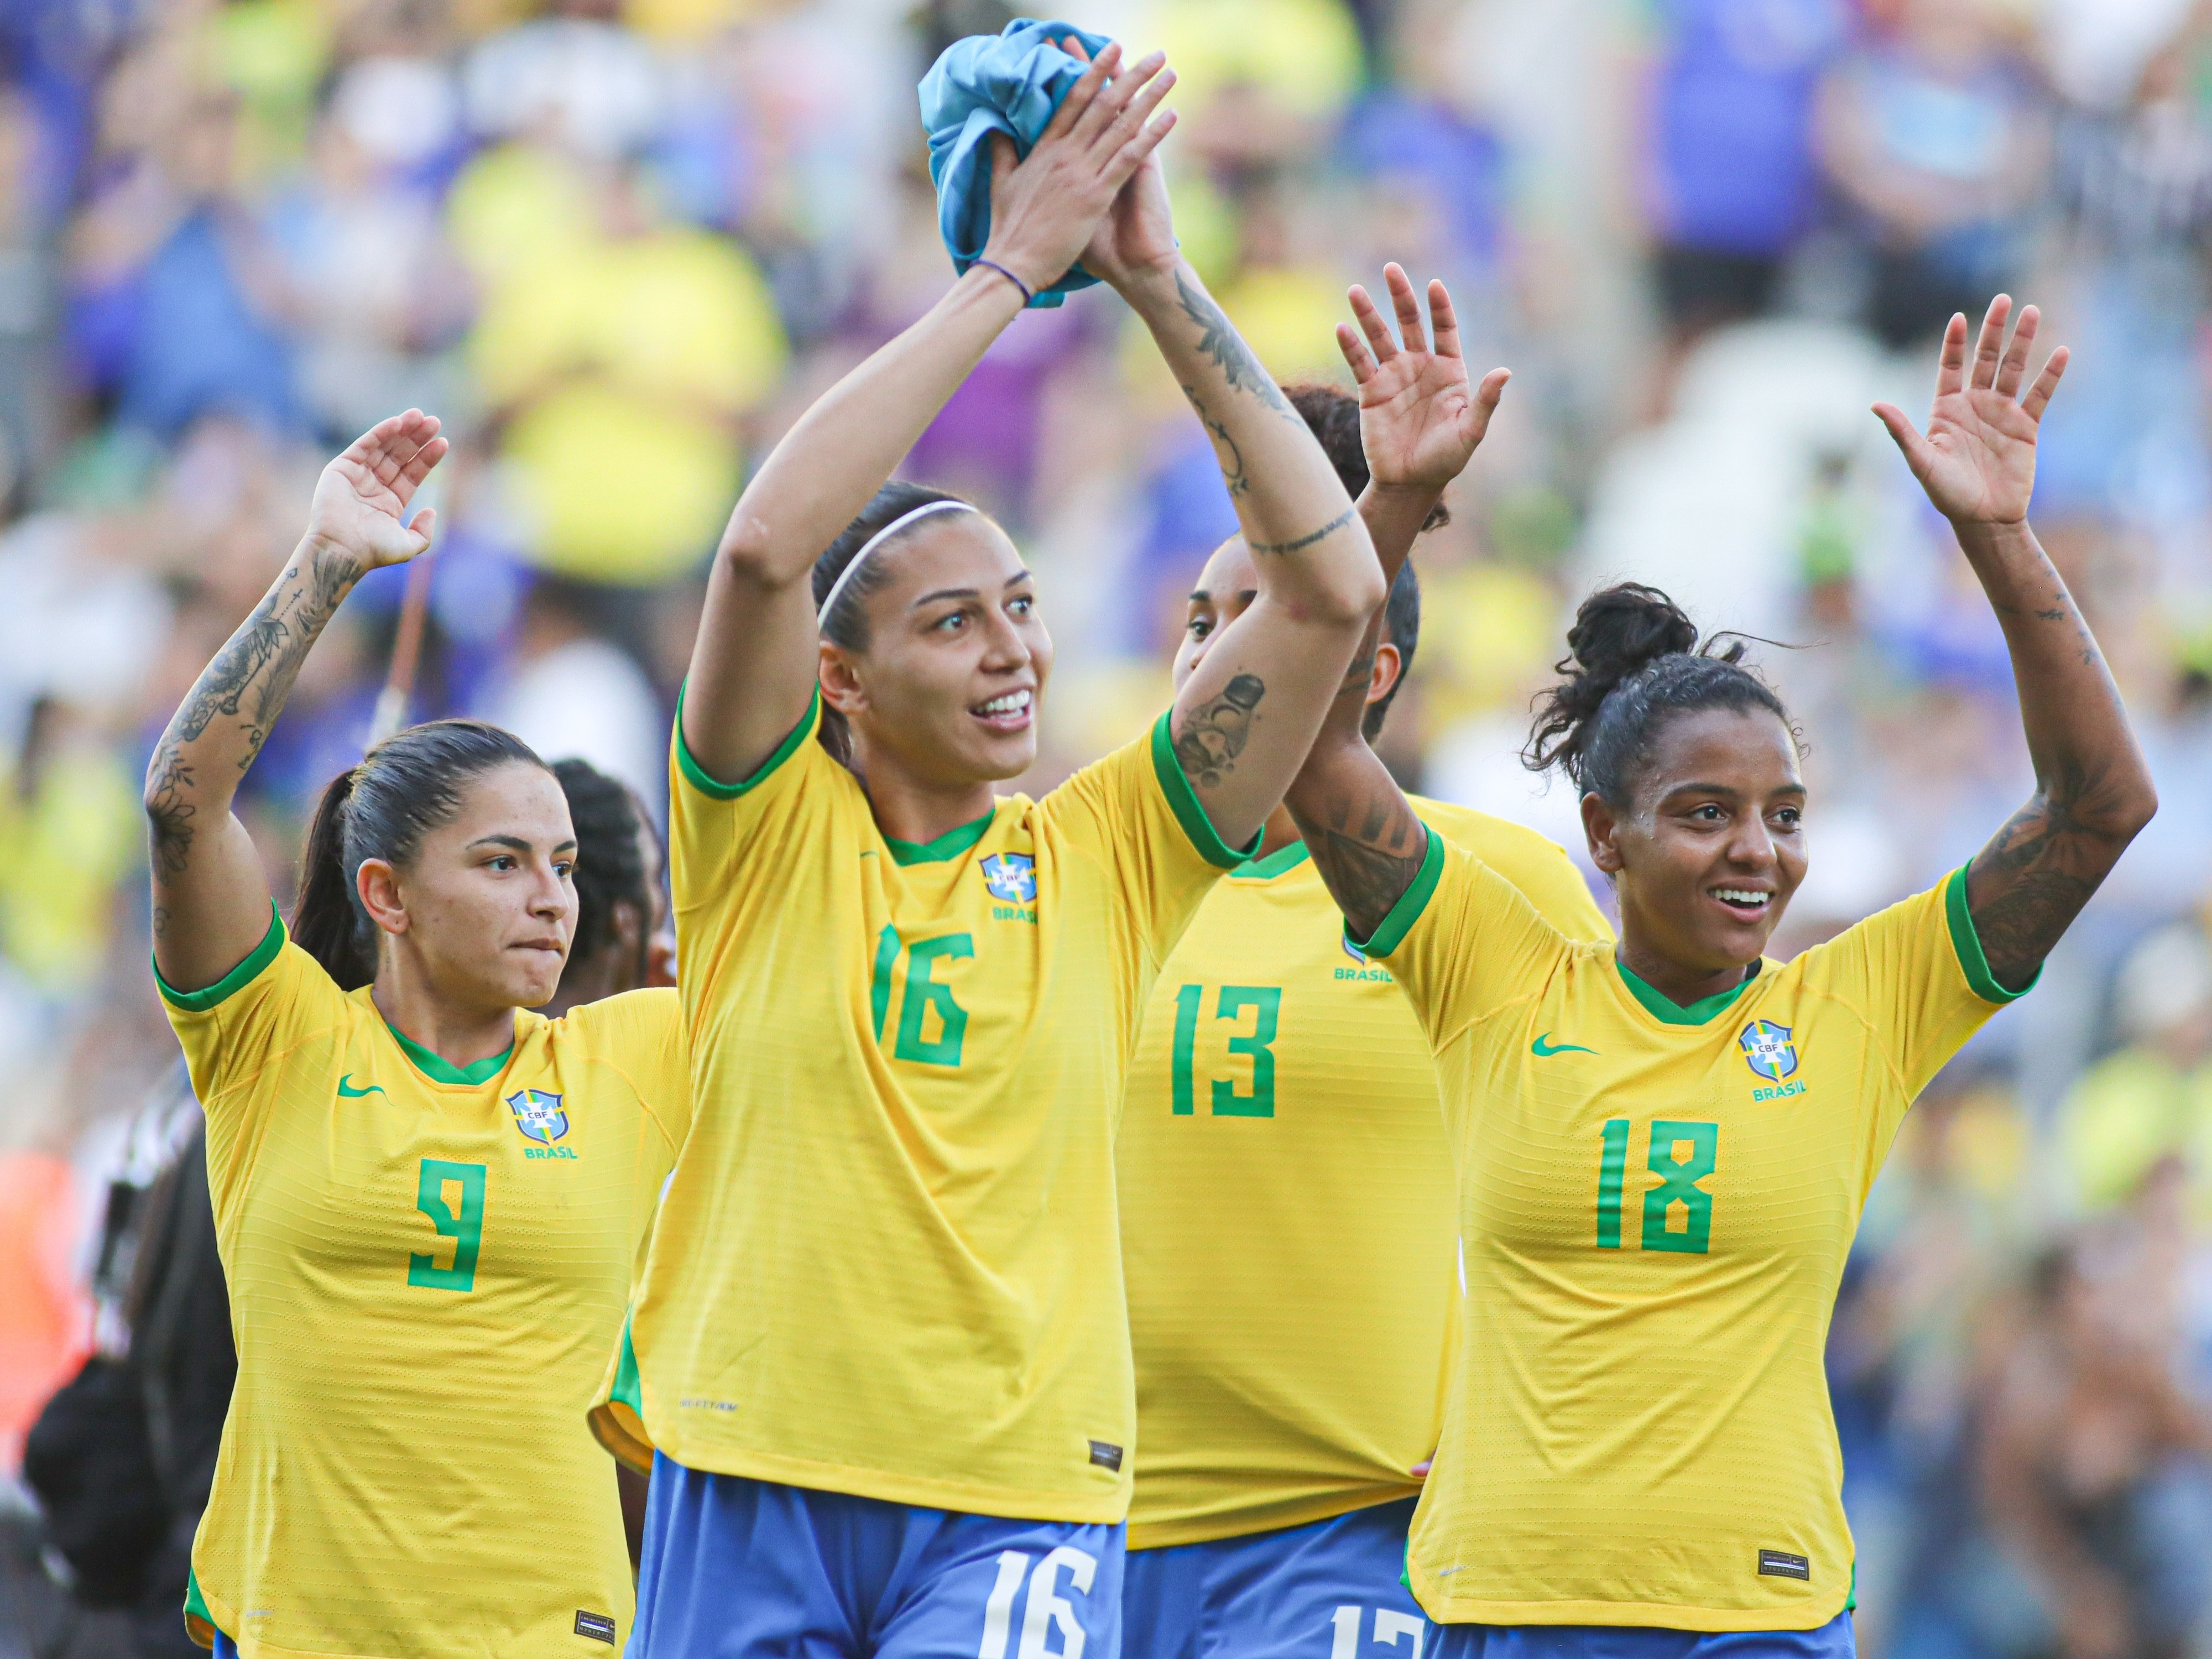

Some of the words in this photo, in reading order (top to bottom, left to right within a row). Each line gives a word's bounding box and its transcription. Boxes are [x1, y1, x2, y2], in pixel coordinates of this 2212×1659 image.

[870, 924, 974, 1067] 16
[1334, 968, 1392, 983] BRASIL
[1171, 984, 1282, 1118] 13
[1752, 1080, 1806, 1102] BRASIL
[1758, 1044, 1778, 1052] CBF
[524, 1146, 578, 1159] BRASIL
[1596, 1119, 1718, 1254] 18
[407, 1159, 487, 1292] 9
[978, 1546, 1097, 1659] 16
